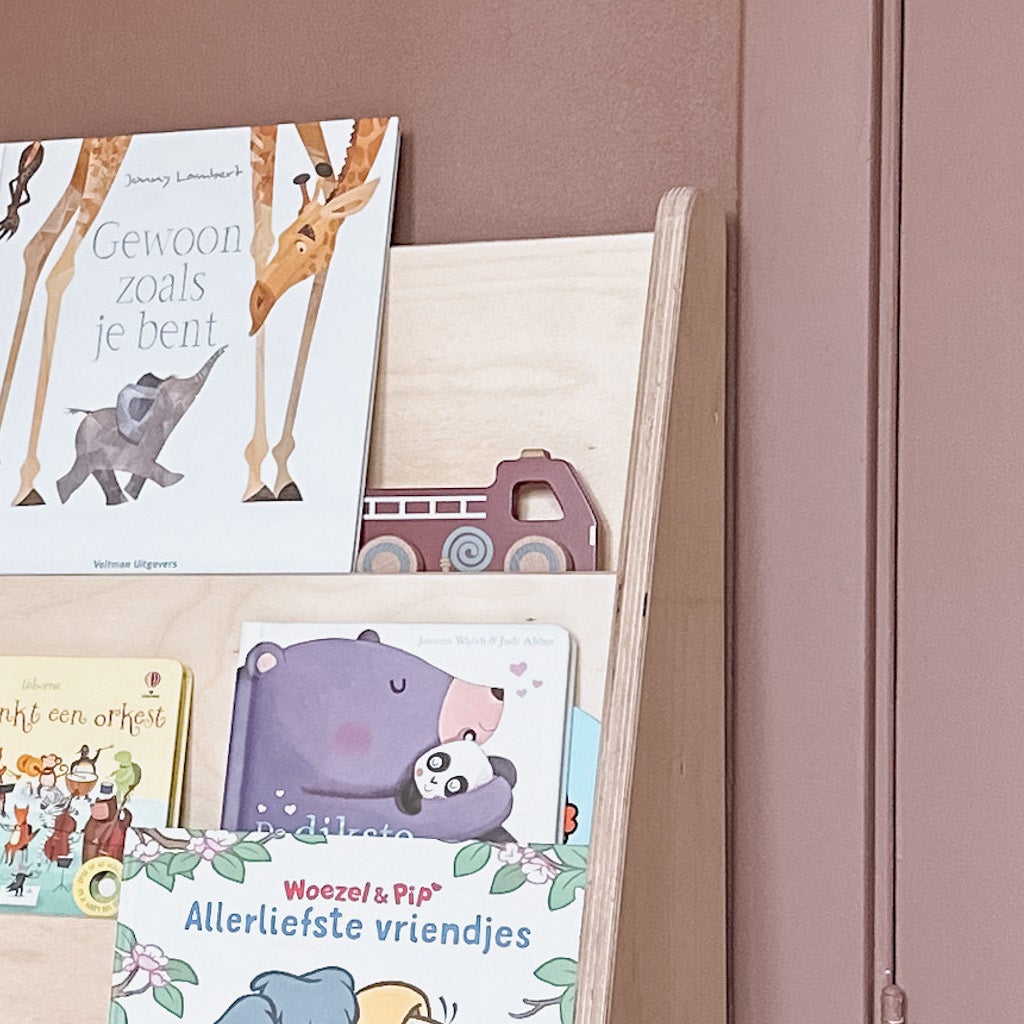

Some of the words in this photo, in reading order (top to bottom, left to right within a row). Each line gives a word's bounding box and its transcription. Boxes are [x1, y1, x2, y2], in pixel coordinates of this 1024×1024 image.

[176, 164, 243, 182] Lambert
[92, 220, 242, 260] Gewoon
[116, 263, 207, 304] zoals
[94, 314, 125, 362] je
[138, 311, 217, 350] bent
[48, 704, 87, 726] een
[93, 702, 166, 737] orkest
[284, 879, 372, 903] Woezel
[375, 886, 389, 905] &
[394, 882, 433, 907] Pip
[184, 900, 364, 941] Allerliefste
[376, 914, 532, 954] vriendjes
